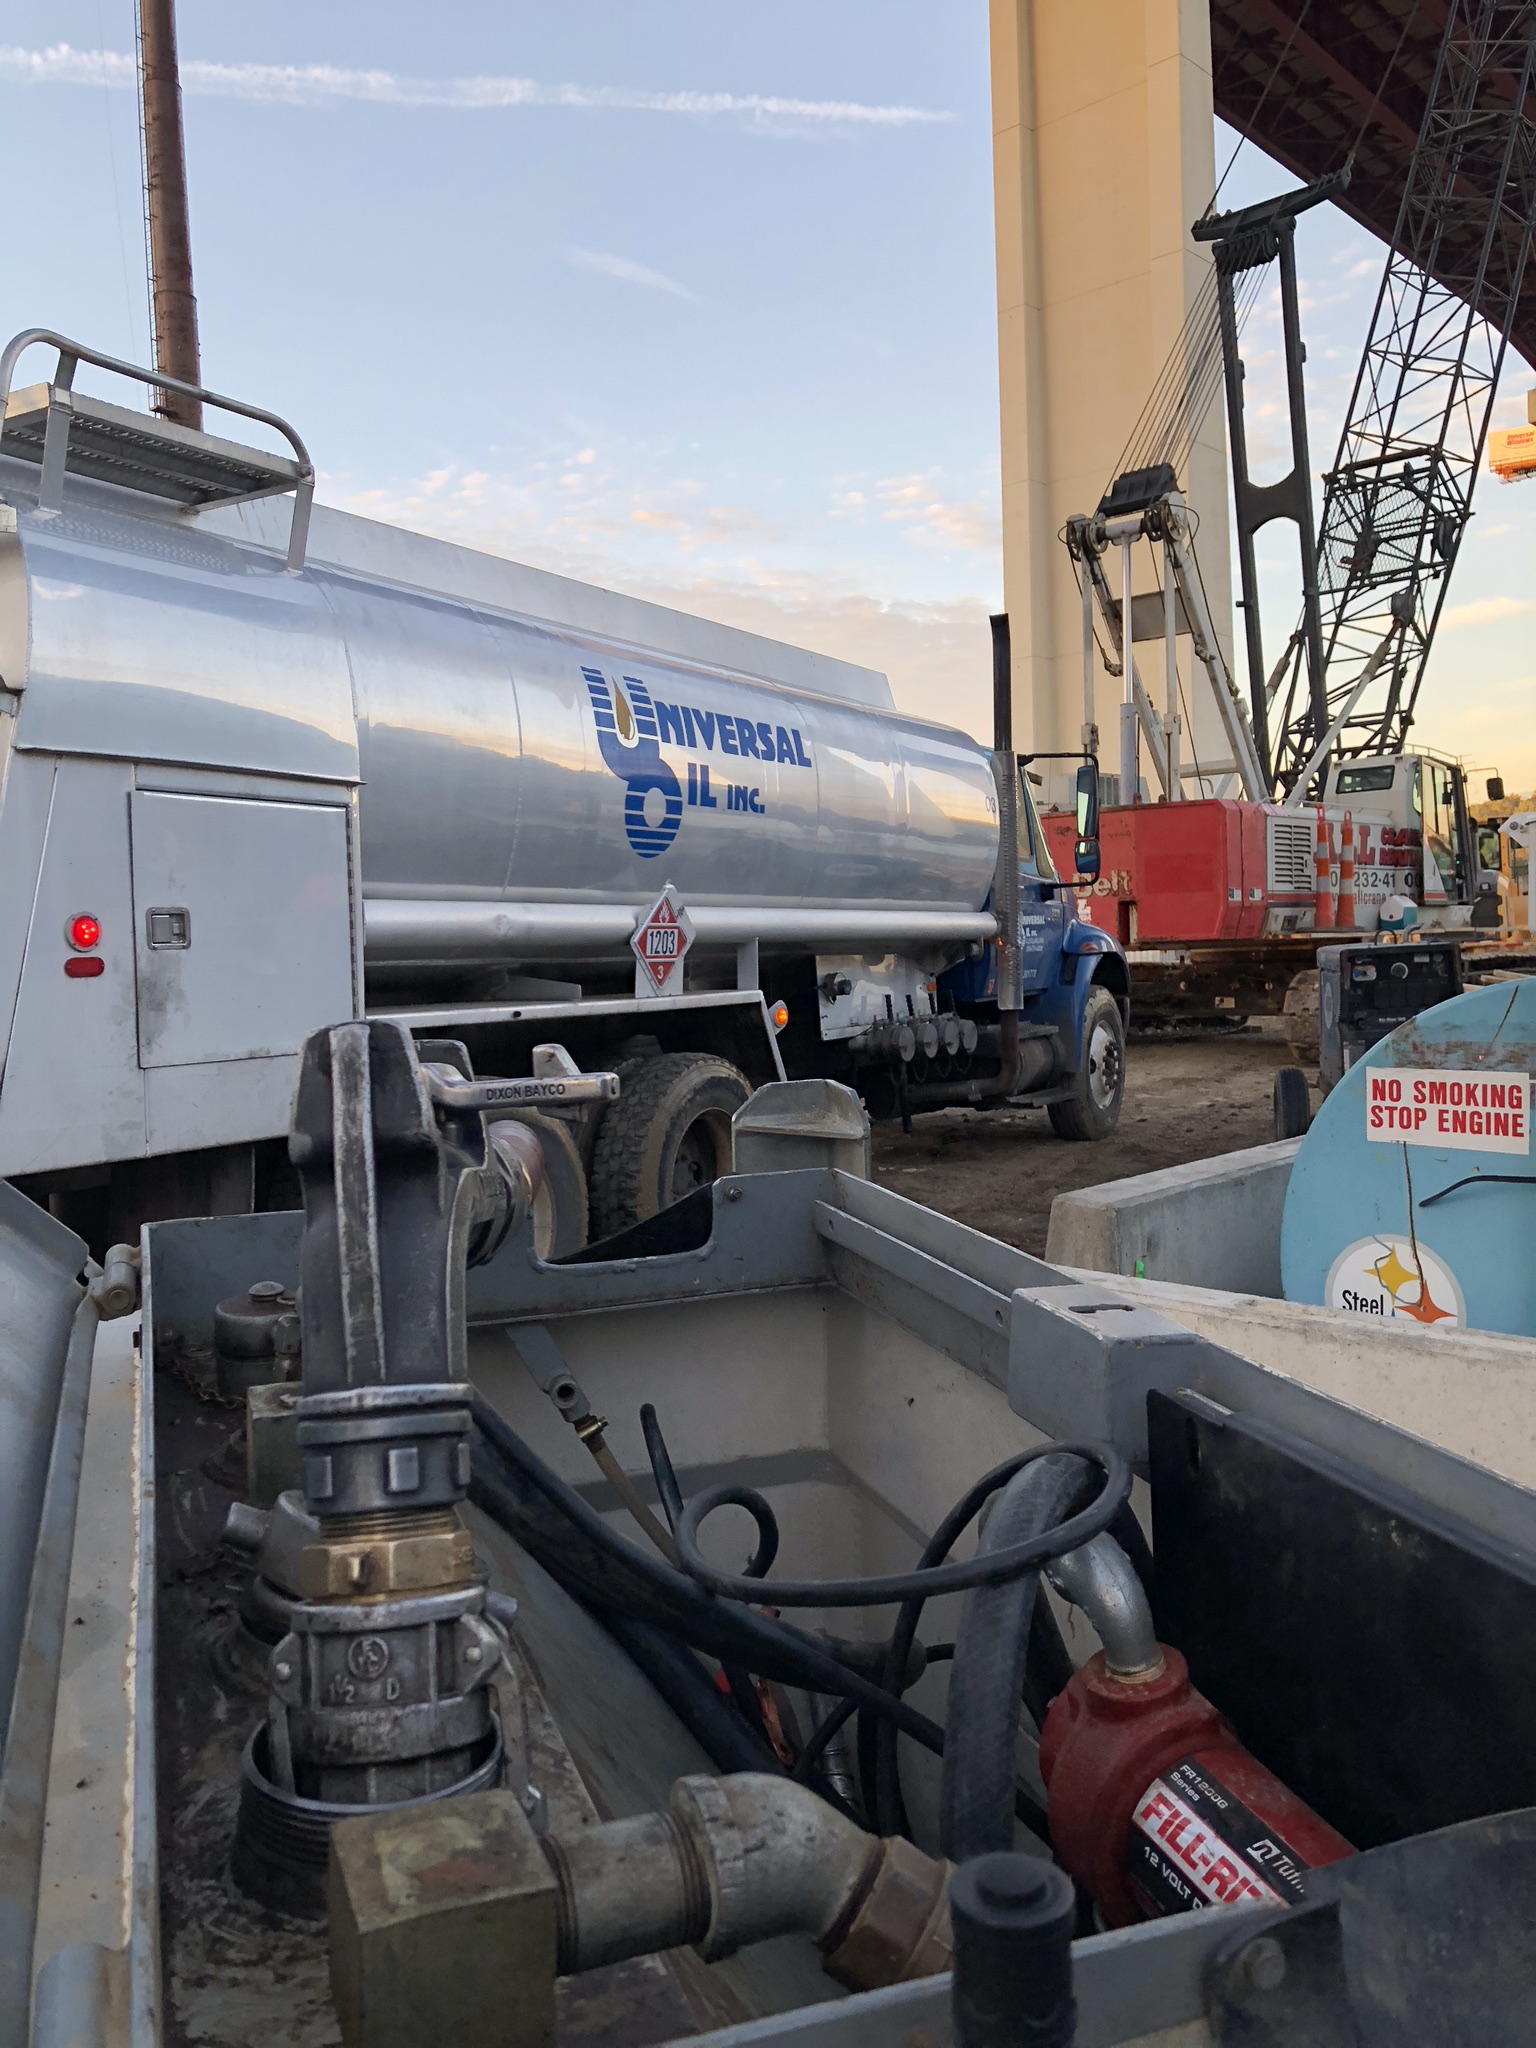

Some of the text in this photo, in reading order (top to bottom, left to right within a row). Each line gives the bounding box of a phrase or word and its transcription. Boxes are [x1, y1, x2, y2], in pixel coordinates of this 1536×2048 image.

[580, 666, 812, 768] UNIVERSAL
[727, 784, 765, 814] INC.
[649, 930, 676, 955] 1203
[658, 965, 664, 980] 3
[486, 1083, 566, 1101] DIXON BAYCO
[1372, 1078, 1523, 1109] NO SMOKING
[1370, 1105, 1524, 1137] STOP ENGINE
[1342, 1289, 1384, 1315] Steel
[1170, 1771, 1201, 1802] Series
[1179, 1764, 1229, 1809] FR1200G
[1144, 1846, 1159, 1868] 12
[1162, 1863, 1192, 1899] VOLT
